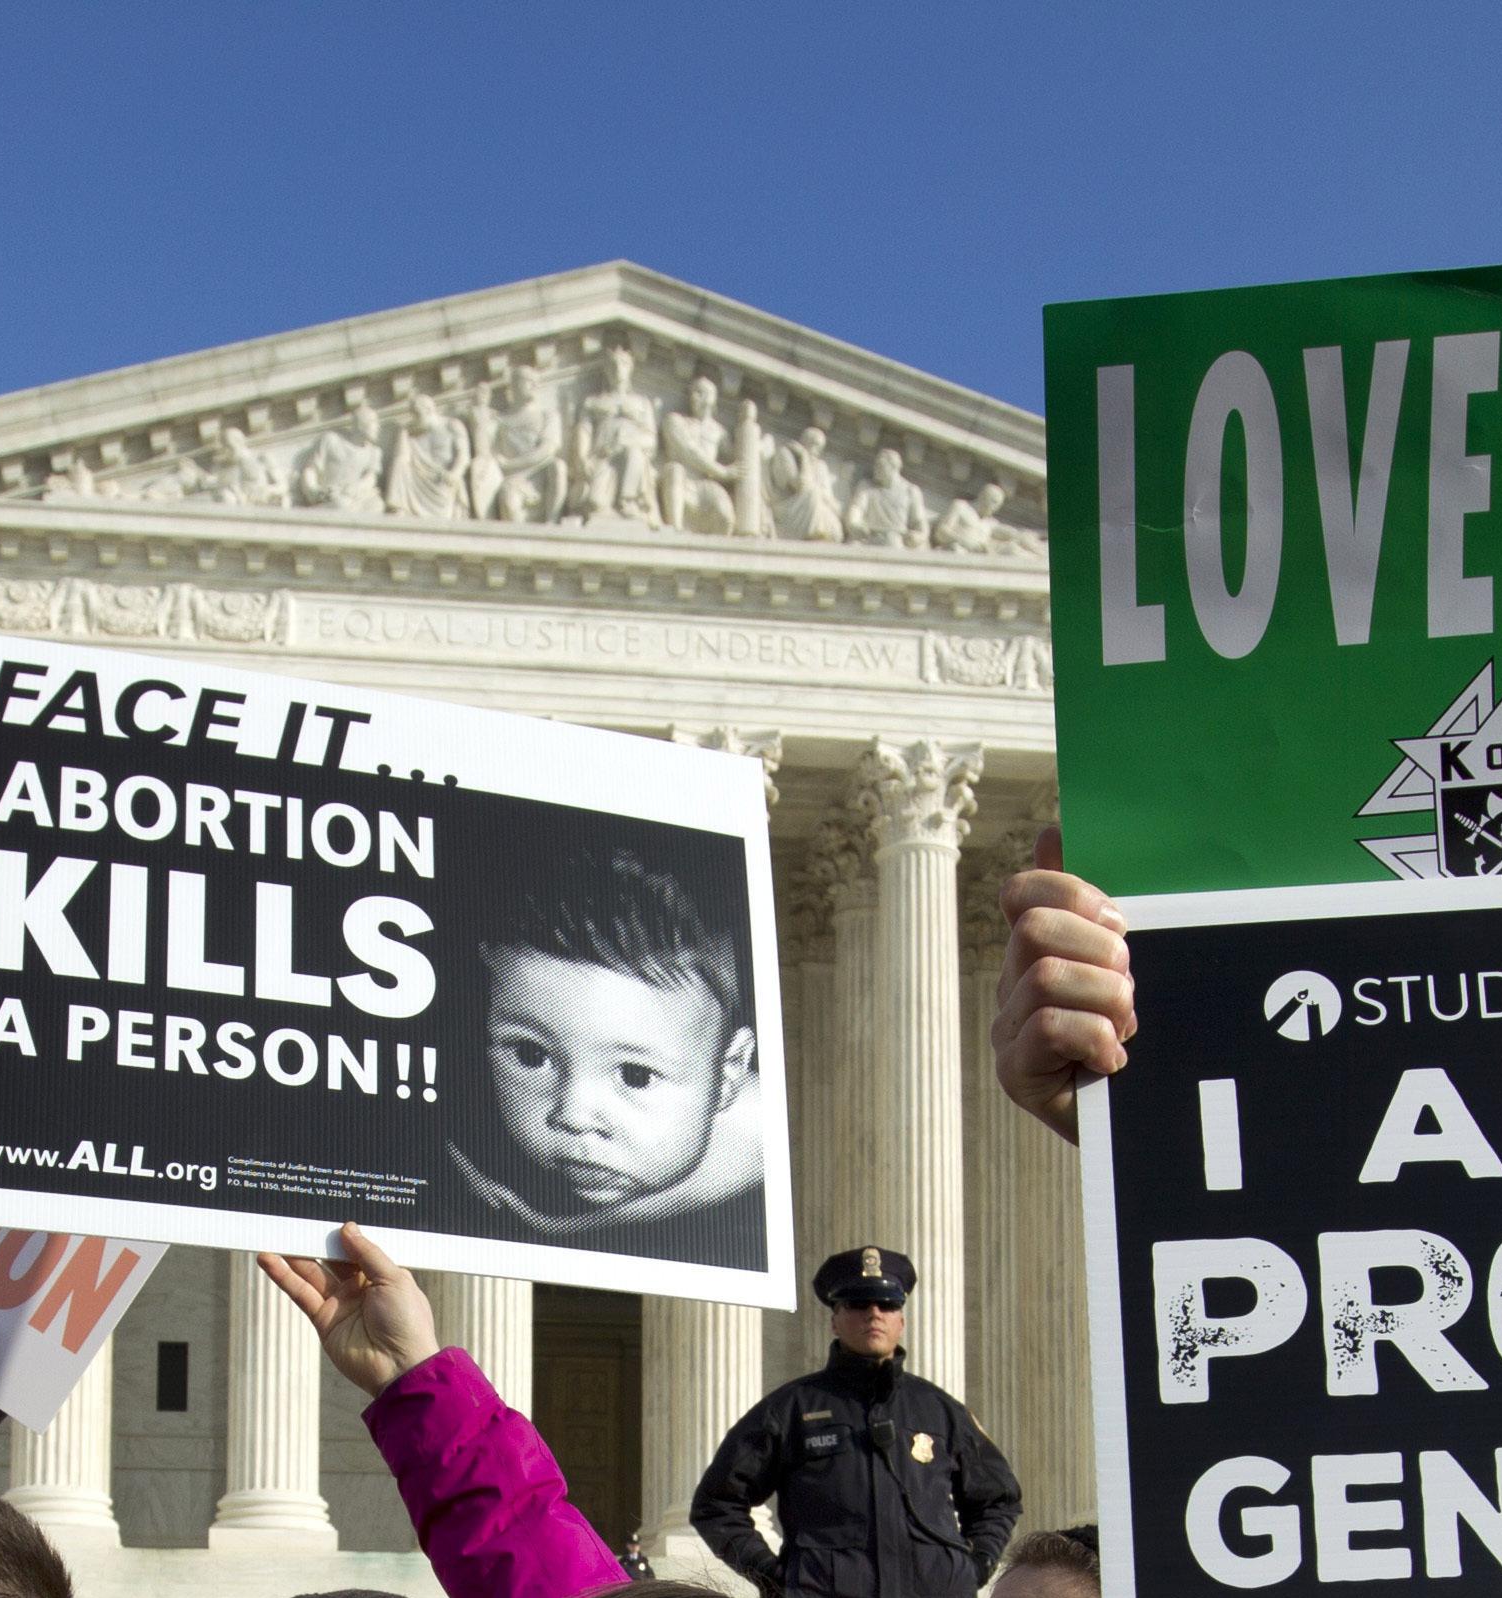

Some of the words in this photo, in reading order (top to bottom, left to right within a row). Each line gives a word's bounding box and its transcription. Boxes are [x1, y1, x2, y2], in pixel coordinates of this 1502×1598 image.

[1096, 330, 1500, 666] LOVE
[318, 608, 465, 643] EQUAL
[474, 616, 640, 656] JUSTICE
[664, 628, 806, 667] UNDER
[822, 637, 900, 669] LAW
[1440, 740, 1475, 782] K
[1198, 1078, 1242, 1190] I
[227, 1156, 277, 1168] Compliments
[278, 1161, 287, 1169] of
[333, 1168, 349, 1176] and
[349, 1170, 384, 1180] American
[386, 1174, 399, 1182] Life
[227, 1167, 266, 1178] Donations
[277, 1173, 298, 1181] offset
[345, 1181, 371, 1190] greatly
[227, 1178, 242, 1187] P.O.
[243, 1180, 257, 1188] Box
[315, 1187, 327, 1196] VA
[804, 1433, 838, 1449] POLICE
